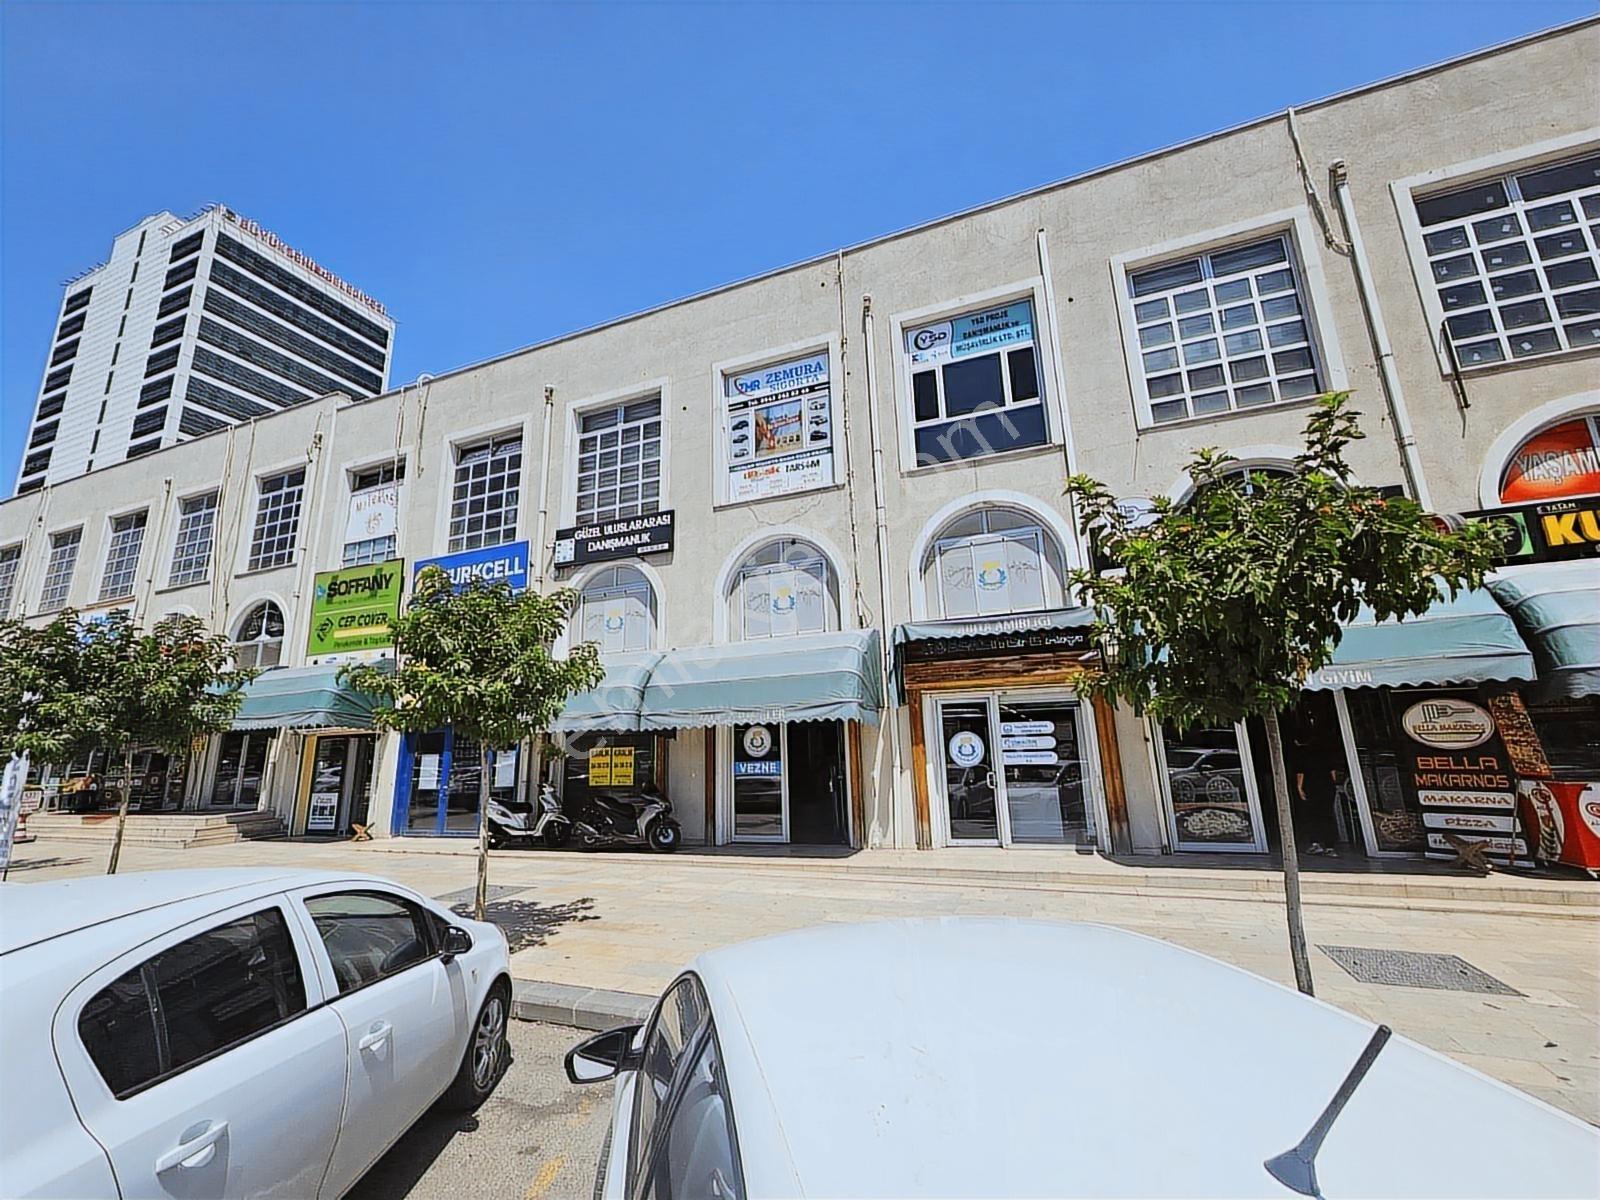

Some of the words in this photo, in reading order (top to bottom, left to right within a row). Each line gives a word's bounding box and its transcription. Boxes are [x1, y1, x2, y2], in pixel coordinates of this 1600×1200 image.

[765, 361, 824, 384] ZEMURA
[1516, 447, 1598, 486] YAŞAM
[574, 526, 602, 540] GÜZEL
[603, 515, 671, 535] ULUSLARARASI
[587, 532, 651, 553] DANIŞMANLIK
[447, 557, 525, 585] URKCELL
[326, 573, 394, 599] SOFFANY
[740, 761, 776, 774] VEZNE
[1417, 756, 1498, 770] BELLA
[1414, 773, 1509, 788] MAKARNOS
[1423, 794, 1512, 805] MAKARNA
